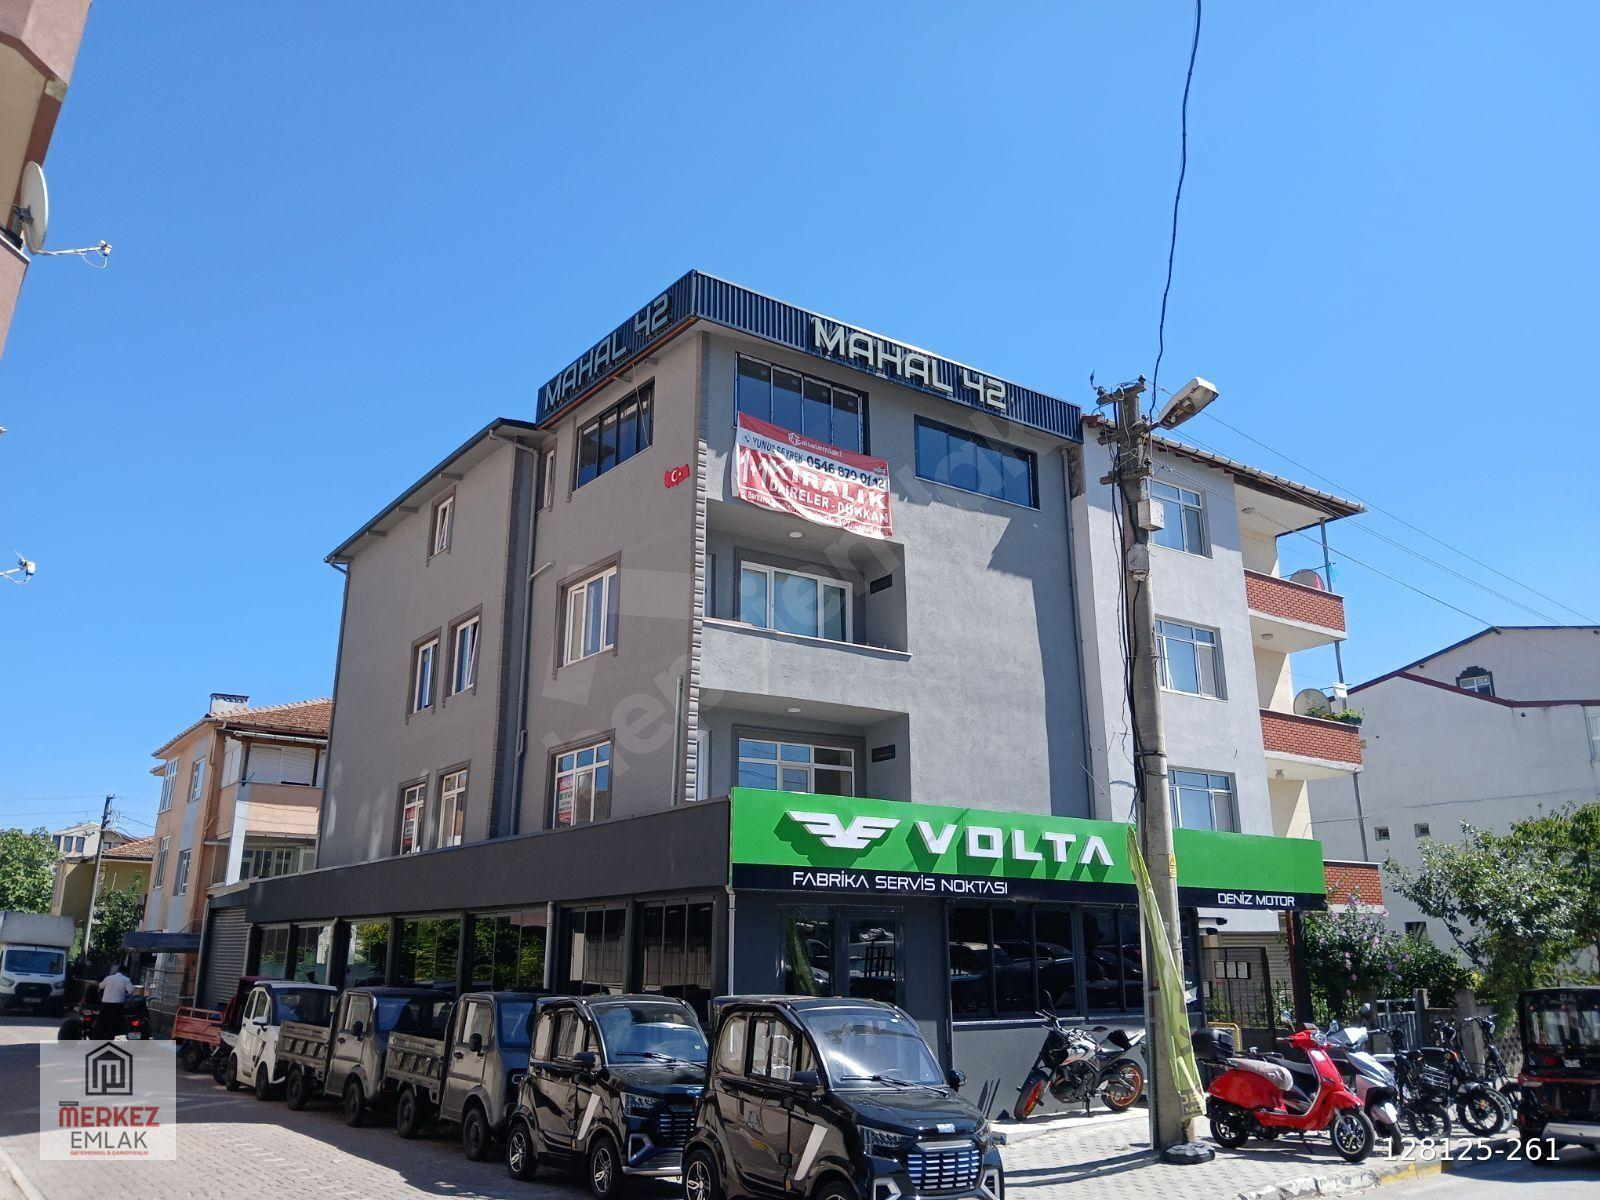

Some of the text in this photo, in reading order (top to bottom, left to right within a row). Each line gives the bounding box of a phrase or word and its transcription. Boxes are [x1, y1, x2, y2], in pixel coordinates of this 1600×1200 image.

[544, 293, 669, 408] MAHAL 42
[813, 316, 1007, 409] MAHAL 42
[806, 455, 835, 475] 0546
[914, 820, 1113, 866] VOLTA
[792, 870, 1008, 895] FABRİKA SERVİS NOKTASI
[1217, 892, 1295, 907] DENİZ MOTOR
